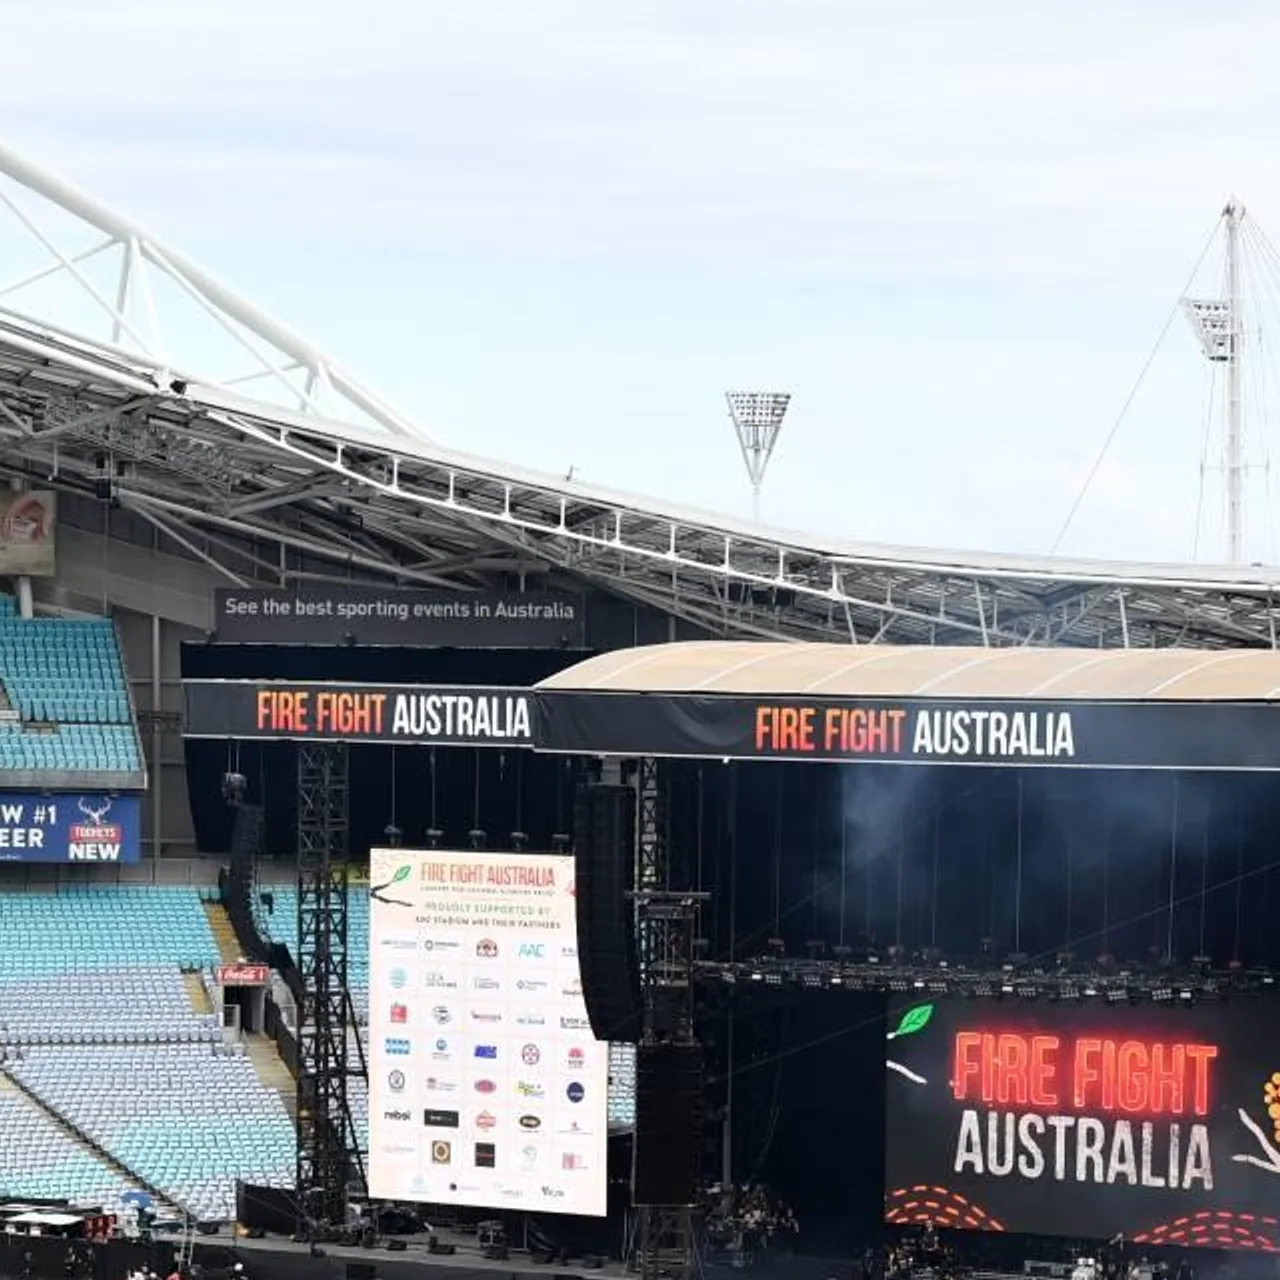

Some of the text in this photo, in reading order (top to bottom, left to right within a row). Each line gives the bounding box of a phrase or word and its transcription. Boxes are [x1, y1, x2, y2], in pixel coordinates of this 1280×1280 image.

[225, 598, 575, 620] See the best sporting events in Australia
[257, 691, 531, 737] FIRE FIGHT AUSTRALIA
[755, 706, 1076, 756] FIRE FIGHT AUSTRALIA
[33, 804, 58, 824] #1
[68, 844, 121, 860] NEW
[421, 863, 556, 887] FIRE FIGHT AUSTRALIA
[953, 1032, 1217, 1116] FIRE FIGHT
[954, 1109, 1214, 1190] AUSTRALIA
